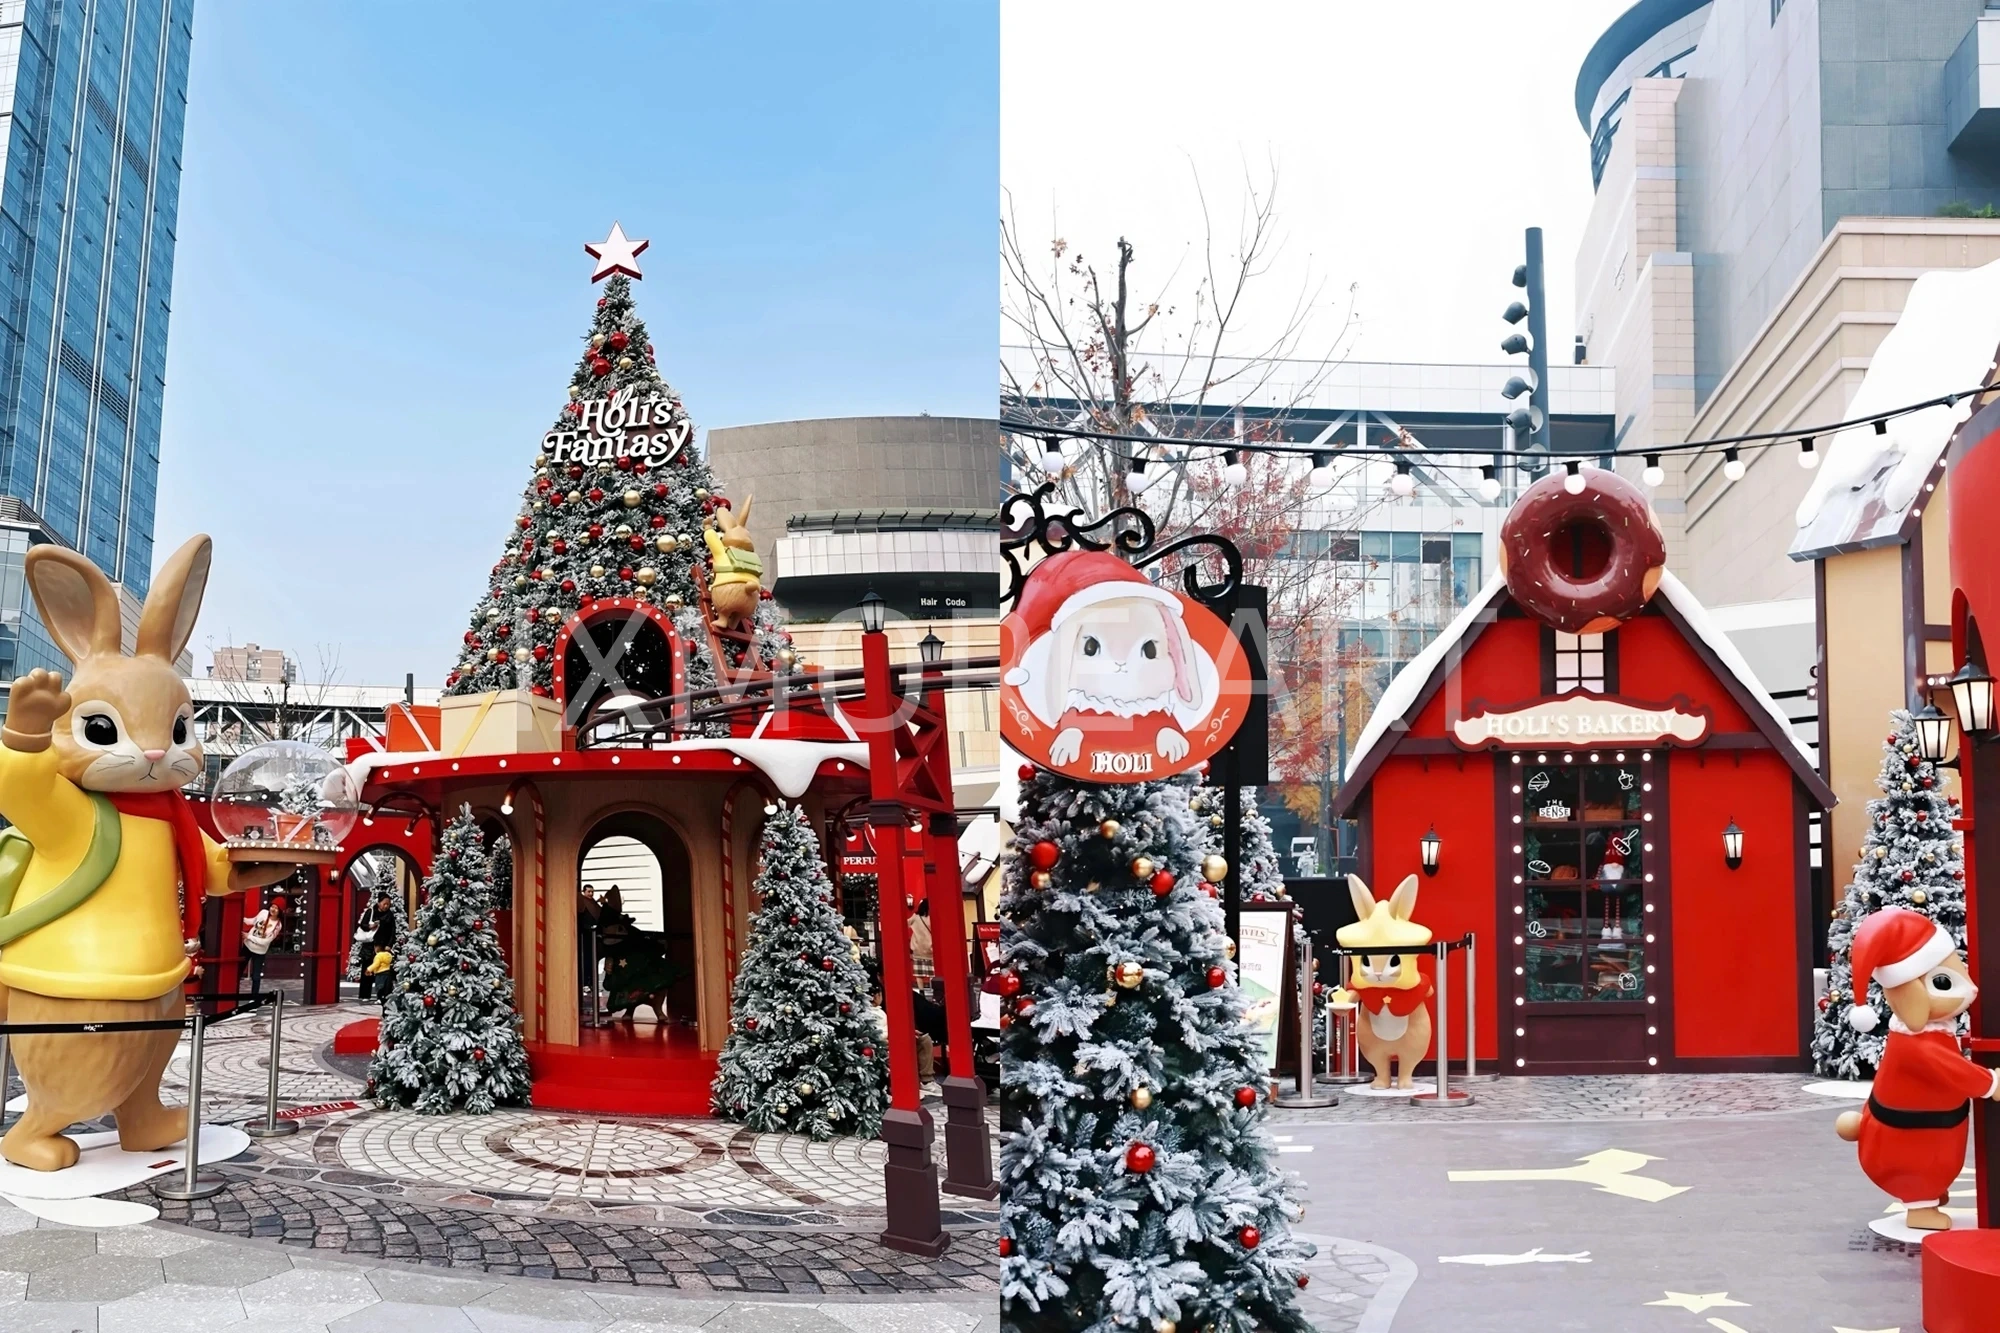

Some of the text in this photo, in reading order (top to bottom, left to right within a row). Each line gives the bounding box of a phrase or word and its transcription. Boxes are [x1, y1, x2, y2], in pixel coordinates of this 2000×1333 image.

[543, 419, 691, 468] Fantasy
[920, 597, 967, 607] Hair Code
[1485, 713, 1676, 737] HOLI'S BAKERY
[1090, 751, 1154, 775] HOLI
[1546, 799, 1564, 807] THE
[1539, 805, 1571, 819] SENSE
[843, 856, 878, 866] PERFU
